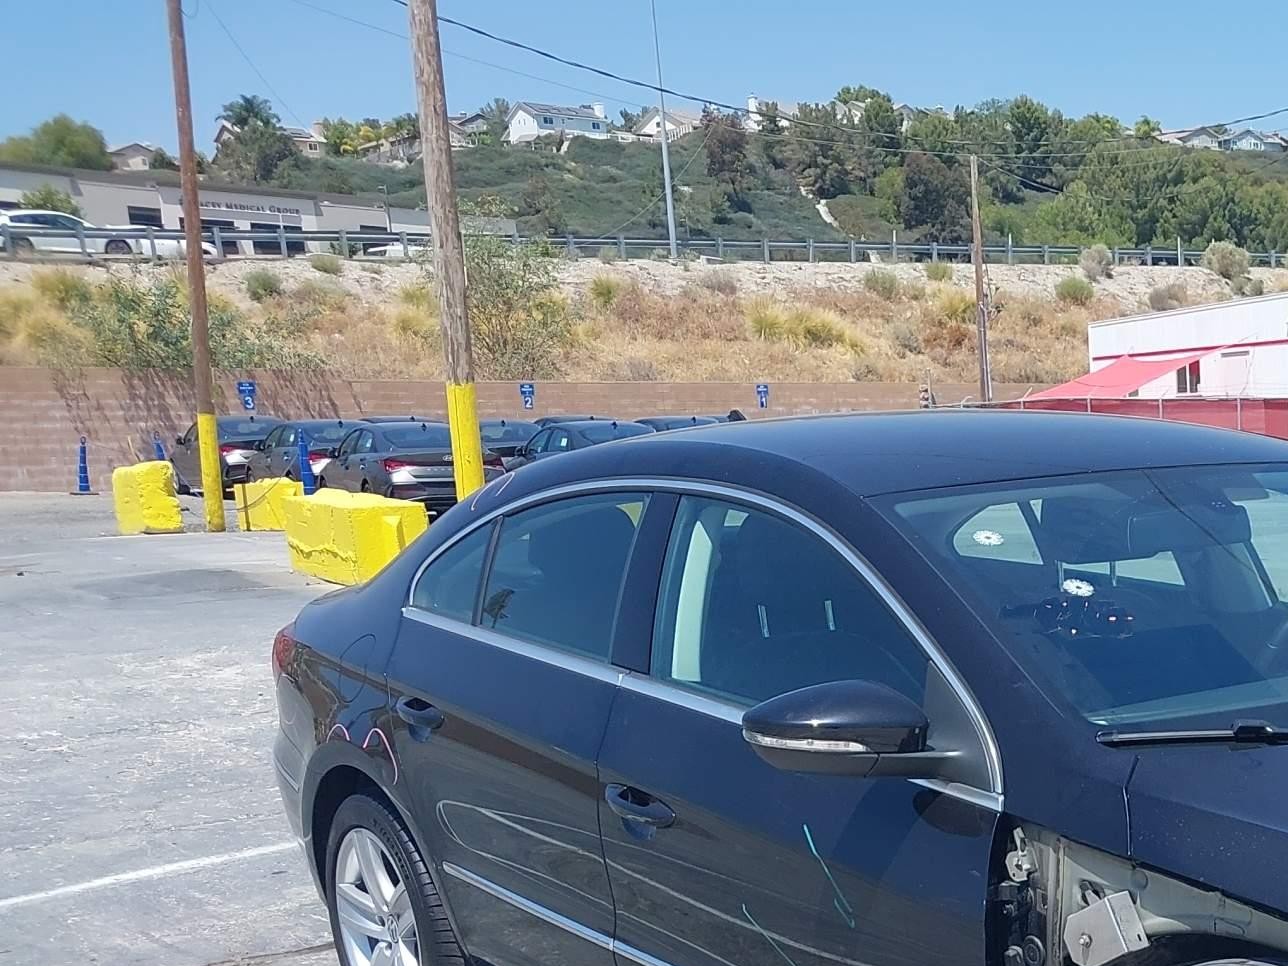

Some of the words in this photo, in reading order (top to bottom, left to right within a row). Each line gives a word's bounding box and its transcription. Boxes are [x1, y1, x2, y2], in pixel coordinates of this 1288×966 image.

[269, 205, 301, 215] GROUP
[244, 396, 254, 409] 3
[524, 396, 533, 408] 2
